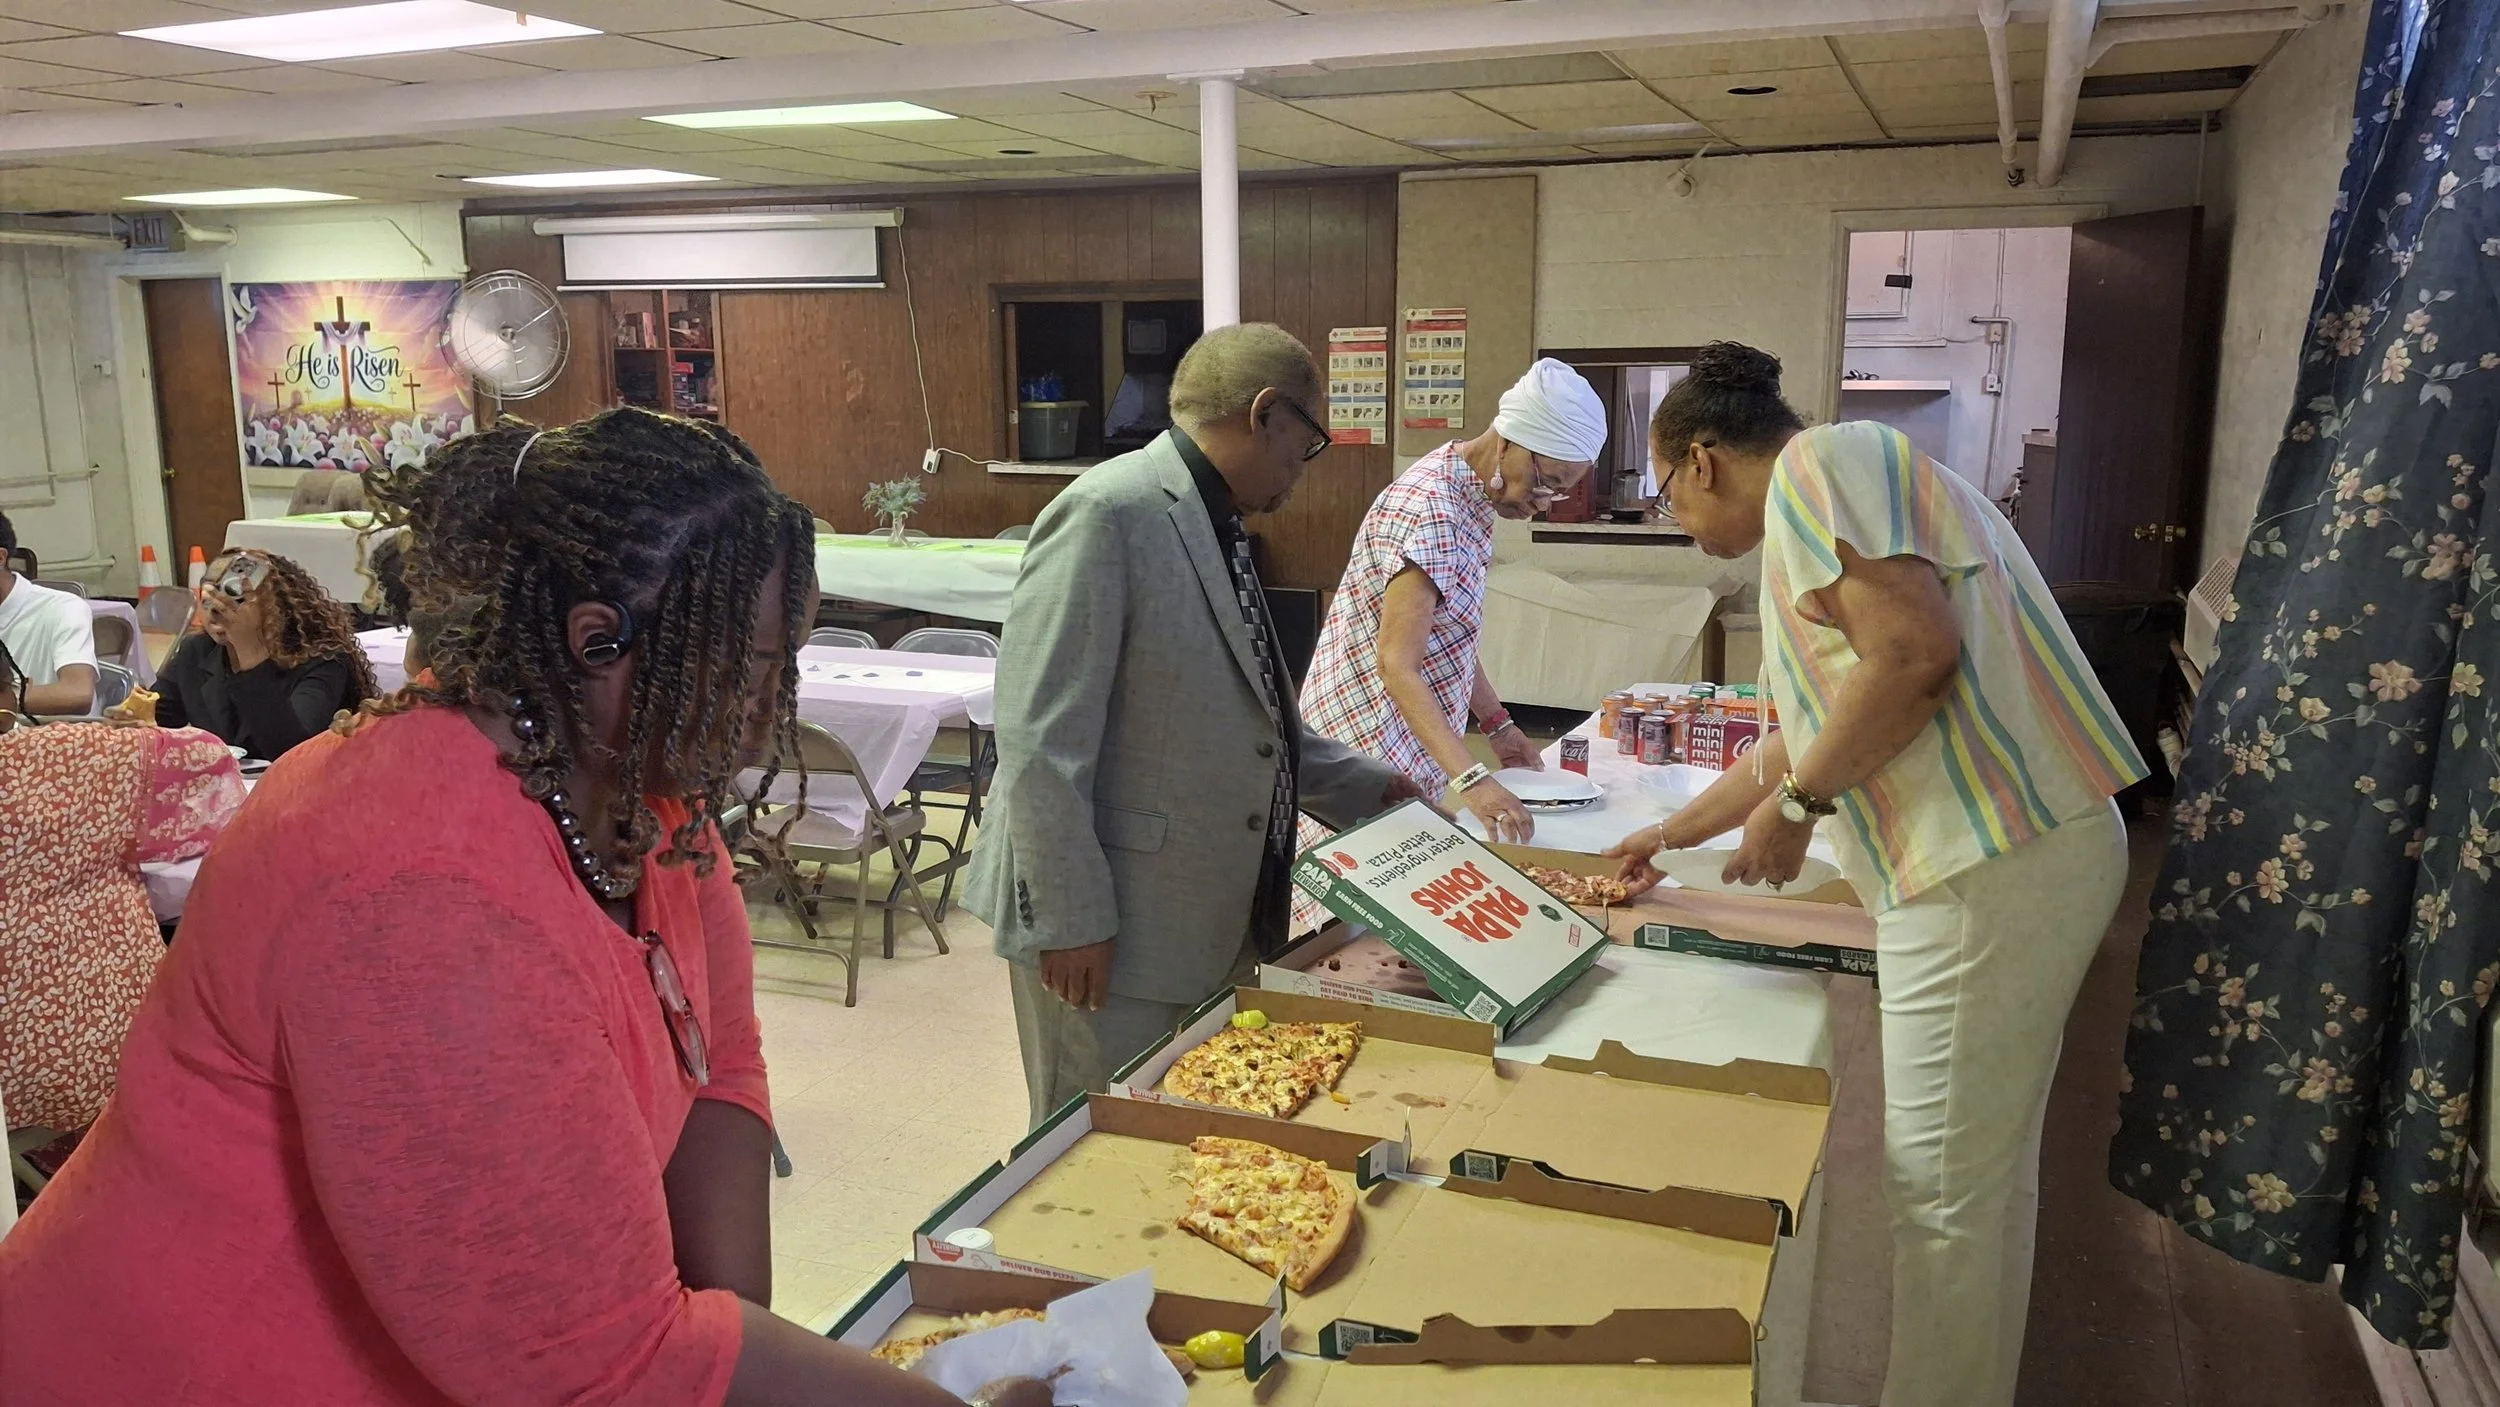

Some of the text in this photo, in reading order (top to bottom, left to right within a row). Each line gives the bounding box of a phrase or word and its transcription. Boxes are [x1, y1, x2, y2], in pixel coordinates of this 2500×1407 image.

[133, 217, 163, 245] EXIT
[285, 343, 405, 392] He is Risen
[1692, 737, 1724, 749] mini
[1693, 725, 1725, 738] mini
[1692, 748, 1723, 760] mini
[1398, 830, 1437, 853] Better
[1427, 834, 1466, 857] Better
[1365, 847, 1405, 868] Pizza.
[1365, 851, 1436, 888] Ingredients.
[1294, 872, 1327, 900] REWARDS
[1300, 861, 1333, 892] PAPA
[1410, 860, 1493, 917] JOHNS
[1335, 890, 1384, 929] EARN FREE FOOD
[1442, 885, 1530, 943] PAPA
